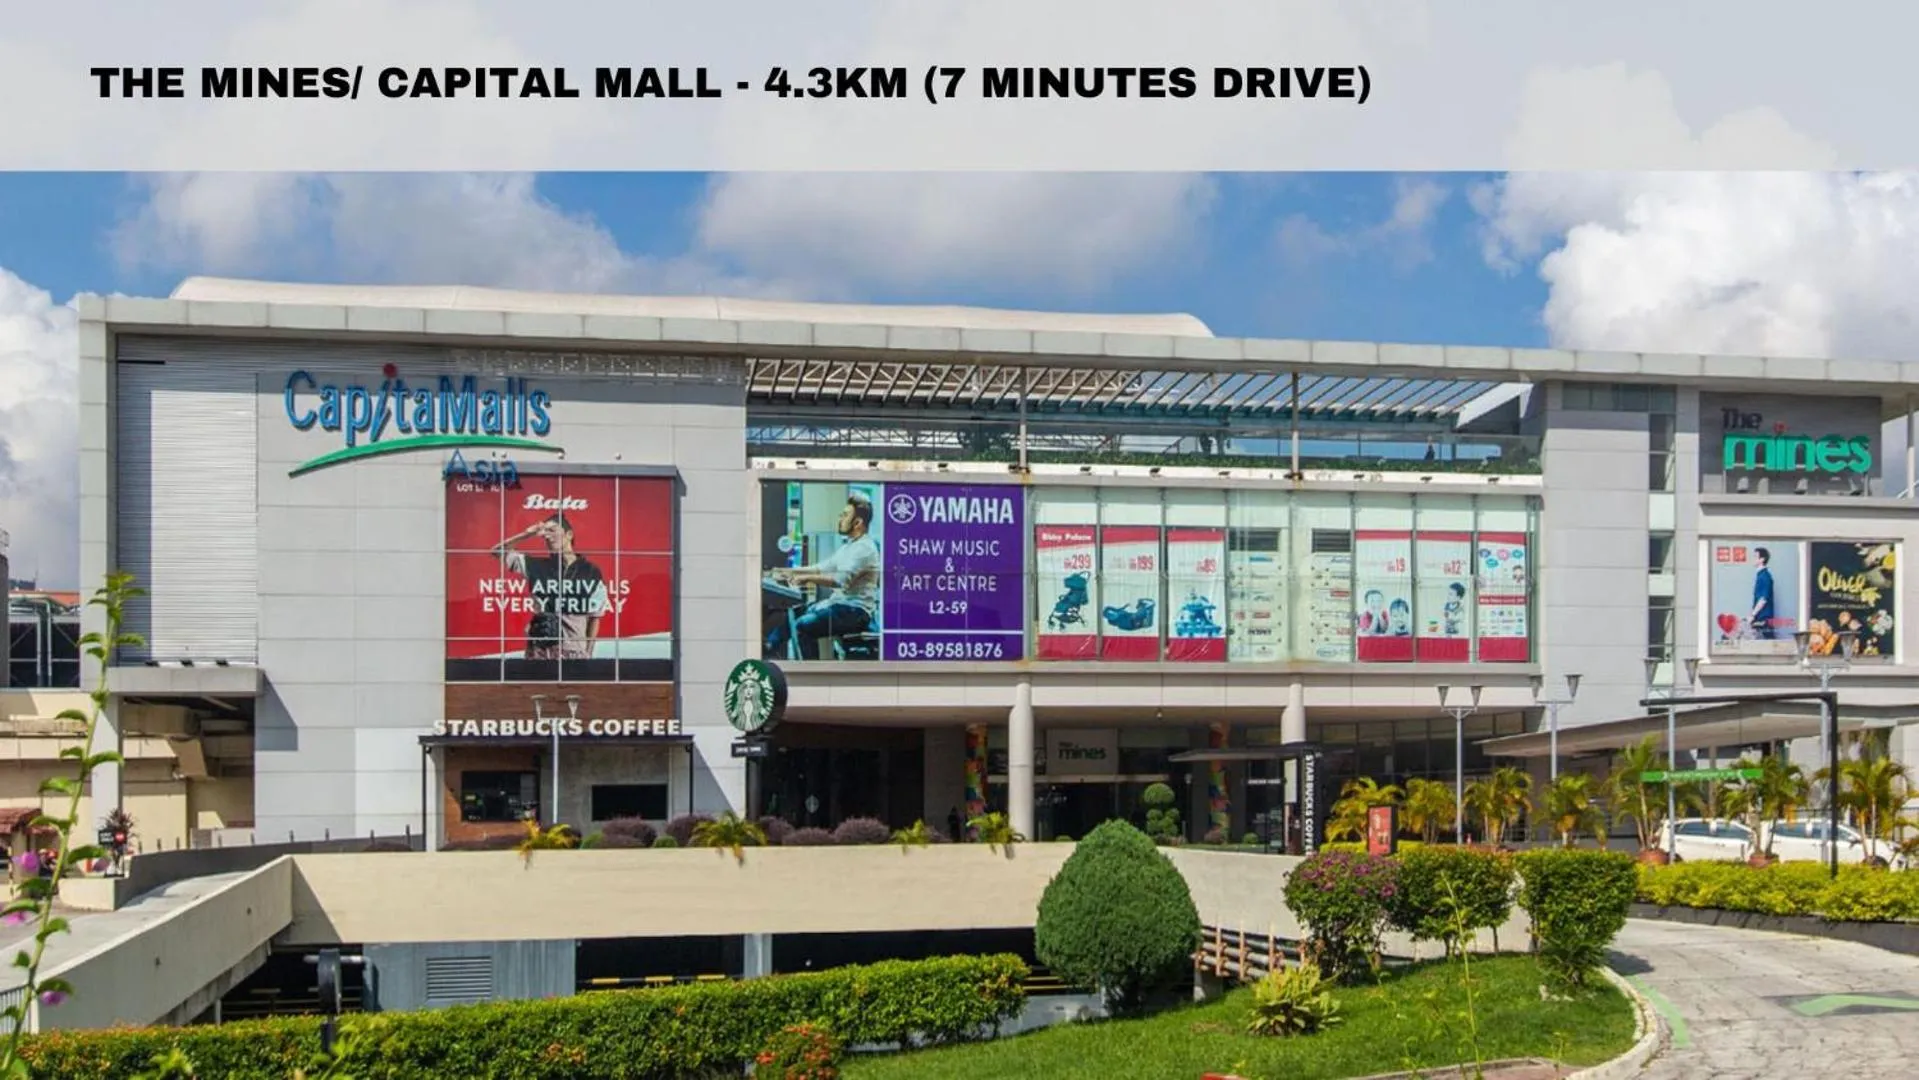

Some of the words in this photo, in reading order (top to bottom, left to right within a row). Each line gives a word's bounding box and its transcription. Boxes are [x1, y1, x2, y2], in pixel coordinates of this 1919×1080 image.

[285, 363, 552, 446] CapitaMalls
[1722, 408, 1763, 430] The
[1724, 421, 1873, 473] mines
[445, 448, 520, 486] Asia
[523, 493, 588, 510] Bata
[920, 496, 1014, 524] YAMAHA
[899, 538, 945, 555] SHAW
[951, 539, 1000, 557] MUSIC
[944, 557, 955, 573] &
[479, 579, 526, 594] NEW
[532, 579, 631, 594] ARRIVALS
[901, 575, 930, 591] ART
[936, 575, 997, 592] CENTRE
[483, 598, 551, 613] EVERY
[554, 598, 628, 613] FRIDAY
[929, 600, 967, 614] L2-59
[898, 641, 1003, 659] 03-89581876
[433, 718, 583, 736] STARBUCKS
[589, 718, 681, 736] COFFEE
[1305, 754, 1315, 816] STARBUCKS
